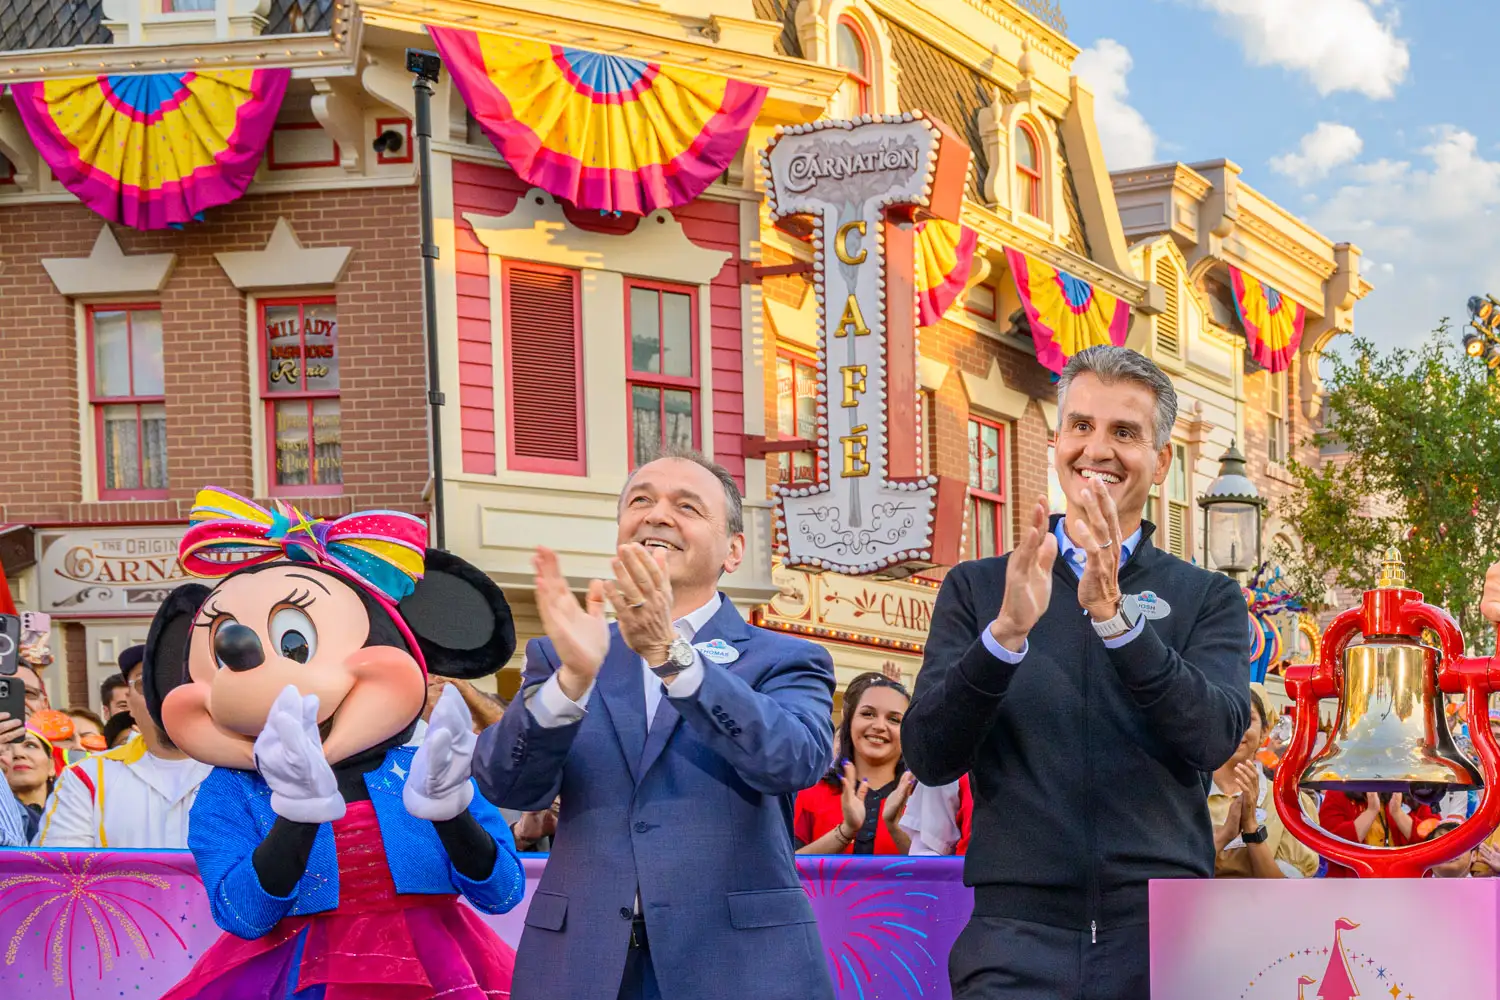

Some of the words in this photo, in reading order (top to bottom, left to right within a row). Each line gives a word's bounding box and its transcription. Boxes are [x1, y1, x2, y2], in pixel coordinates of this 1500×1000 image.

[787, 143, 919, 192] CARNATION
[834, 220, 871, 478] CAFÉ
[54, 546, 190, 585] CARNA
[102, 541, 121, 551] THE
[126, 539, 180, 554] ORIGIN
[881, 593, 935, 632] CARN
